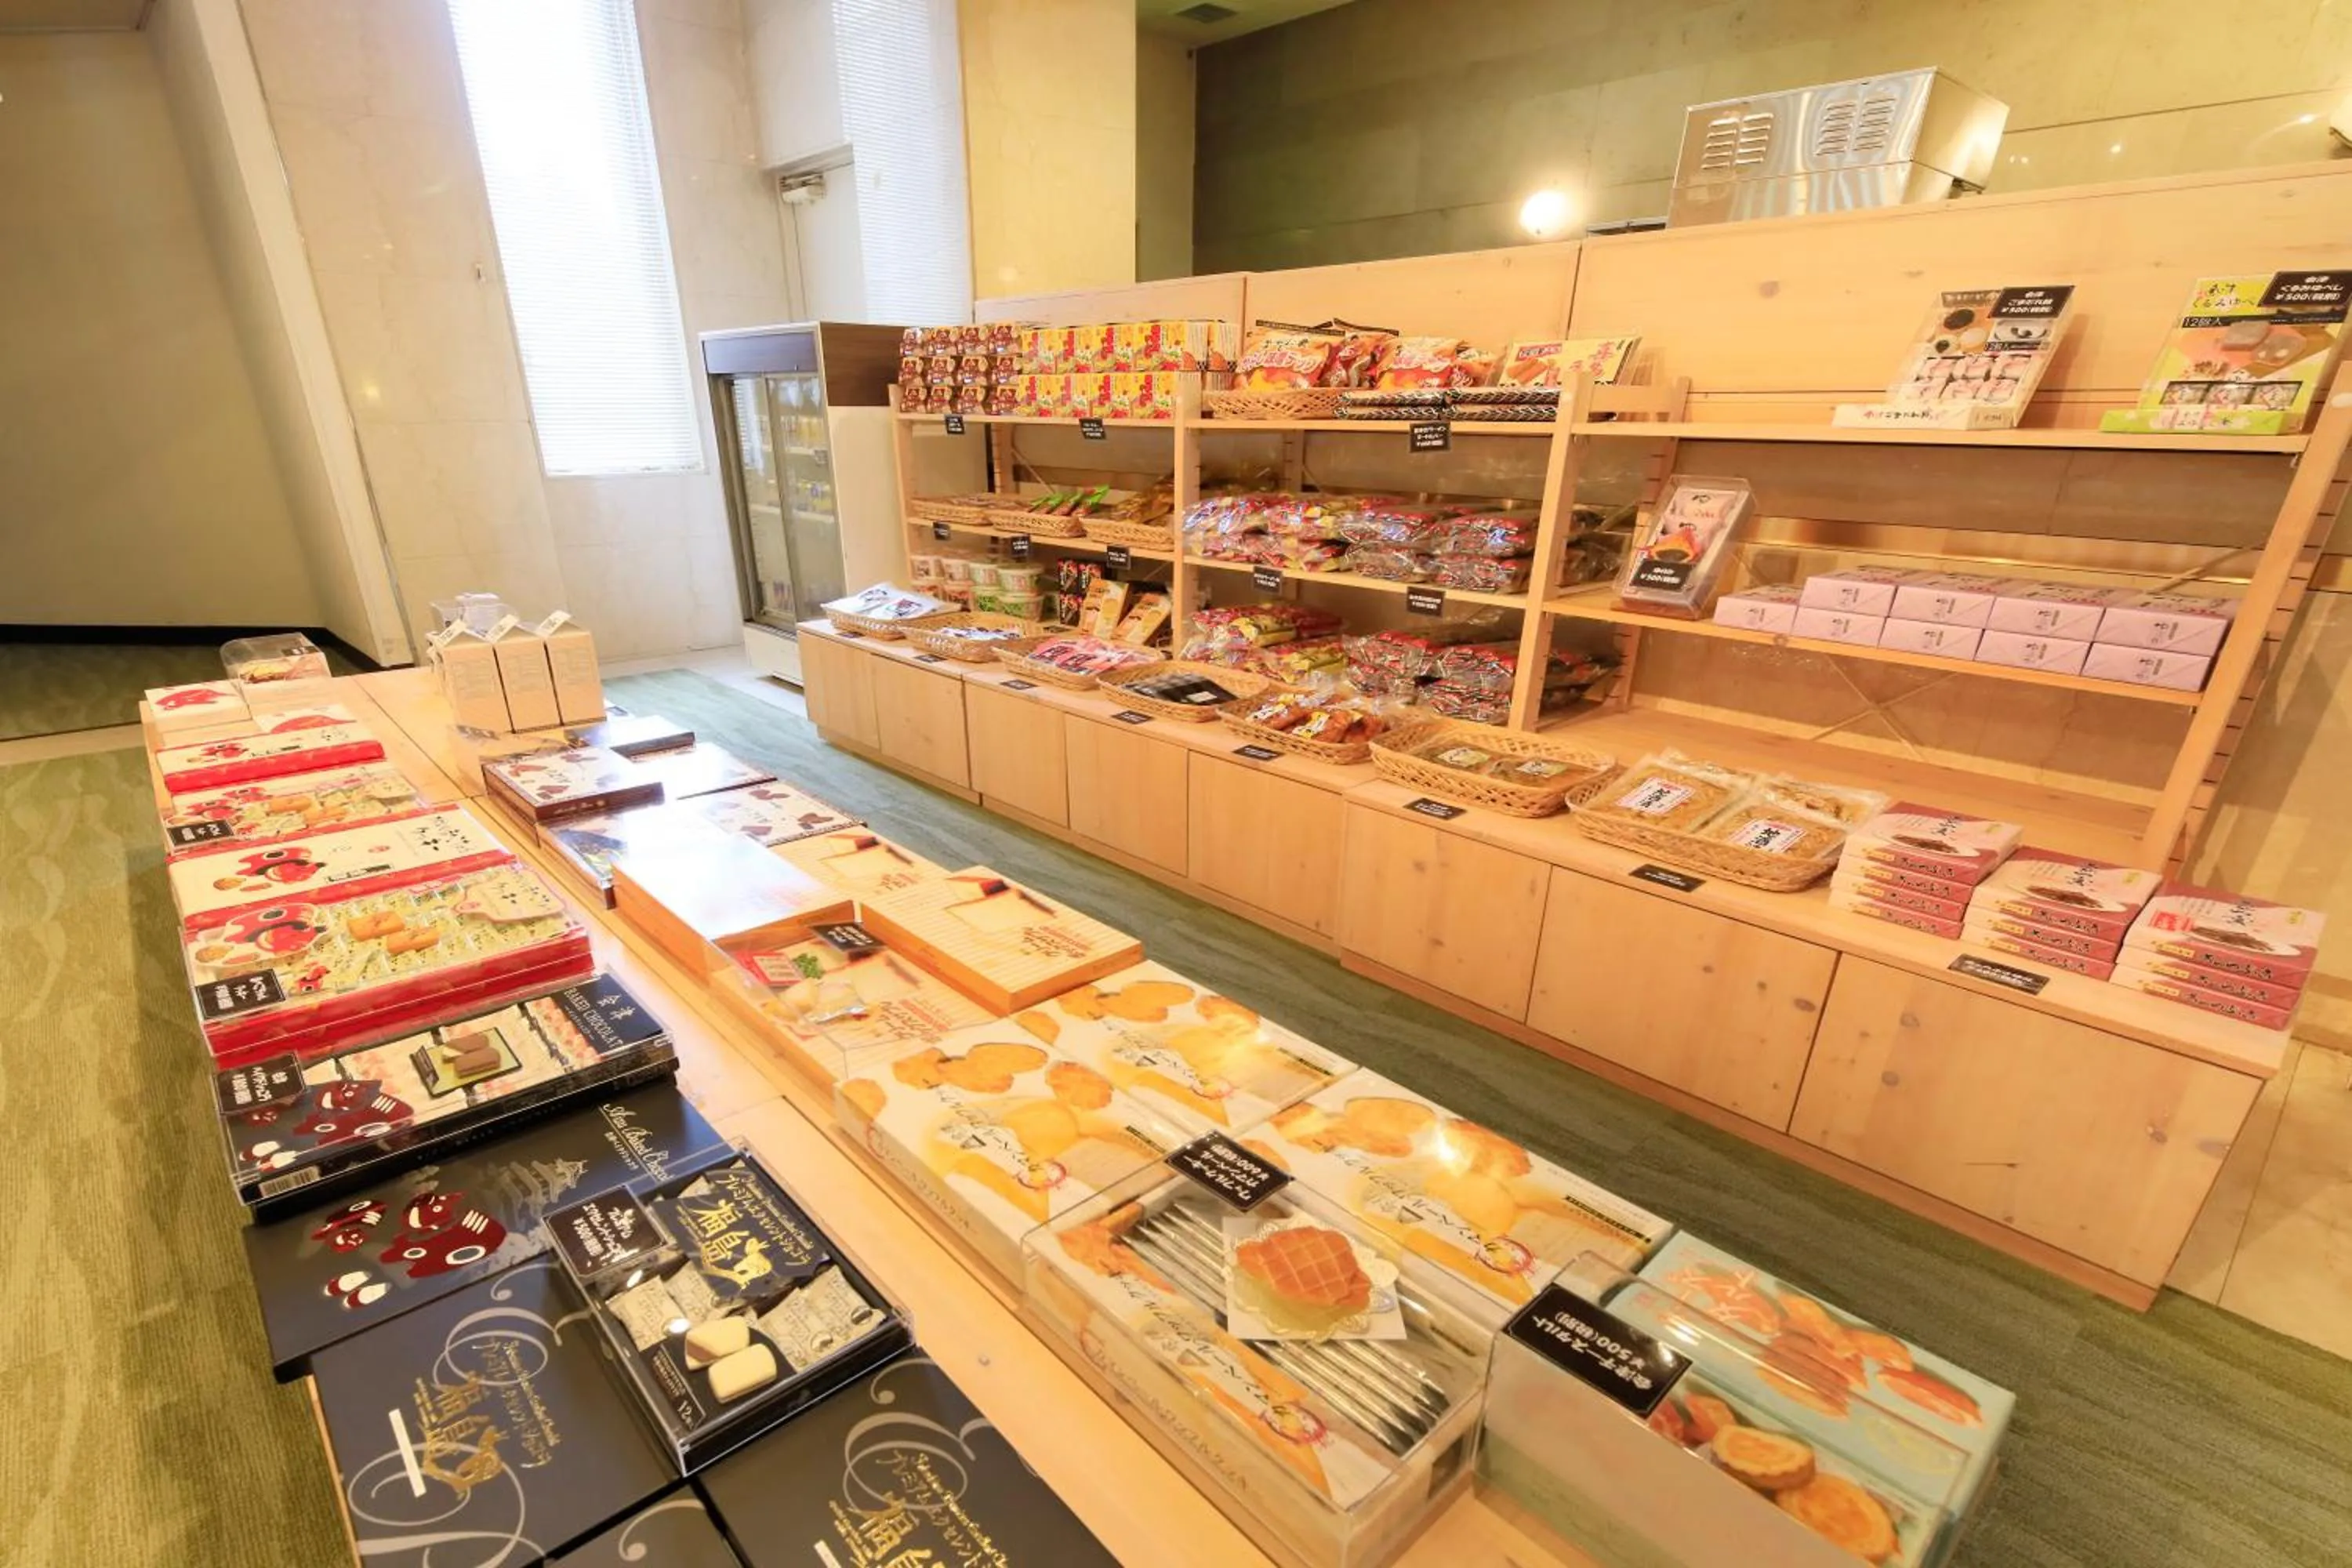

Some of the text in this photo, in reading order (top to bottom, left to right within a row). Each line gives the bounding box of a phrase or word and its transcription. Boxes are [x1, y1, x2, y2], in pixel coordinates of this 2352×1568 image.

[693, 1199, 750, 1265] 福島
[1555, 1312, 1646, 1369] ¥500(税別)
[875, 1450, 994, 1568] プレミアムエクセレント
